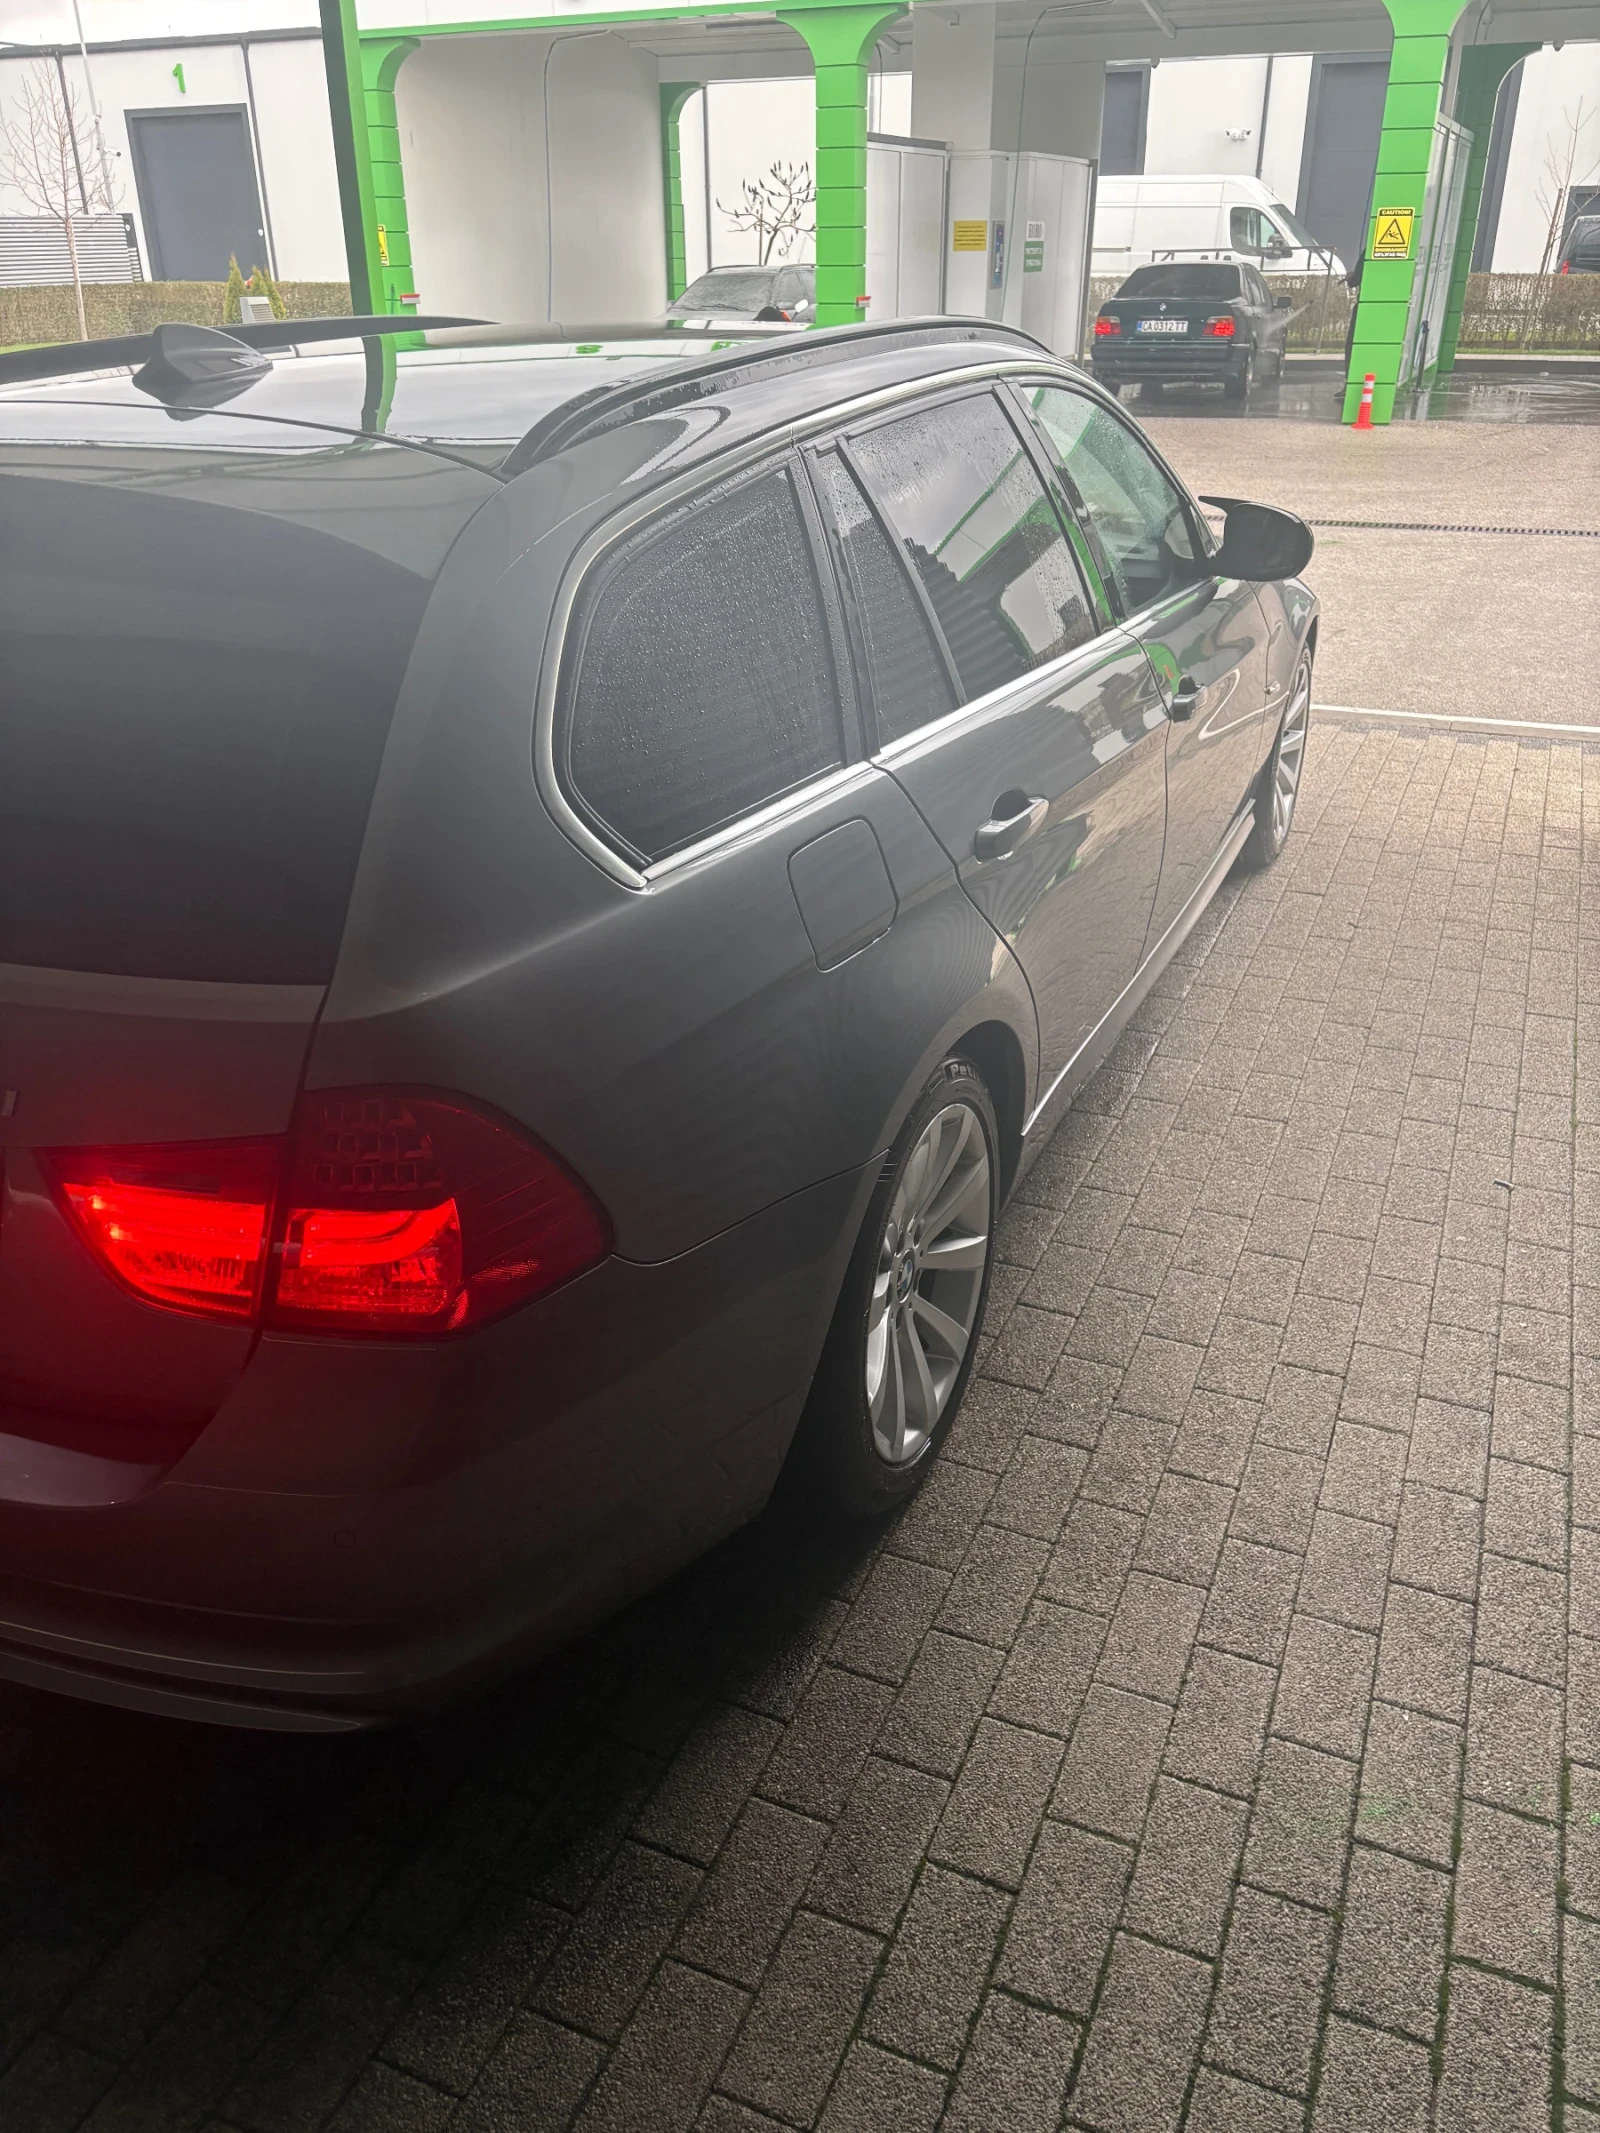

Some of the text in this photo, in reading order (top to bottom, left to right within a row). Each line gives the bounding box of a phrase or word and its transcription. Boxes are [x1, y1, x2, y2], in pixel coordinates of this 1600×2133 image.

[172, 63, 186, 93] 1
[1143, 322, 1186, 331] CA 0312 TT
